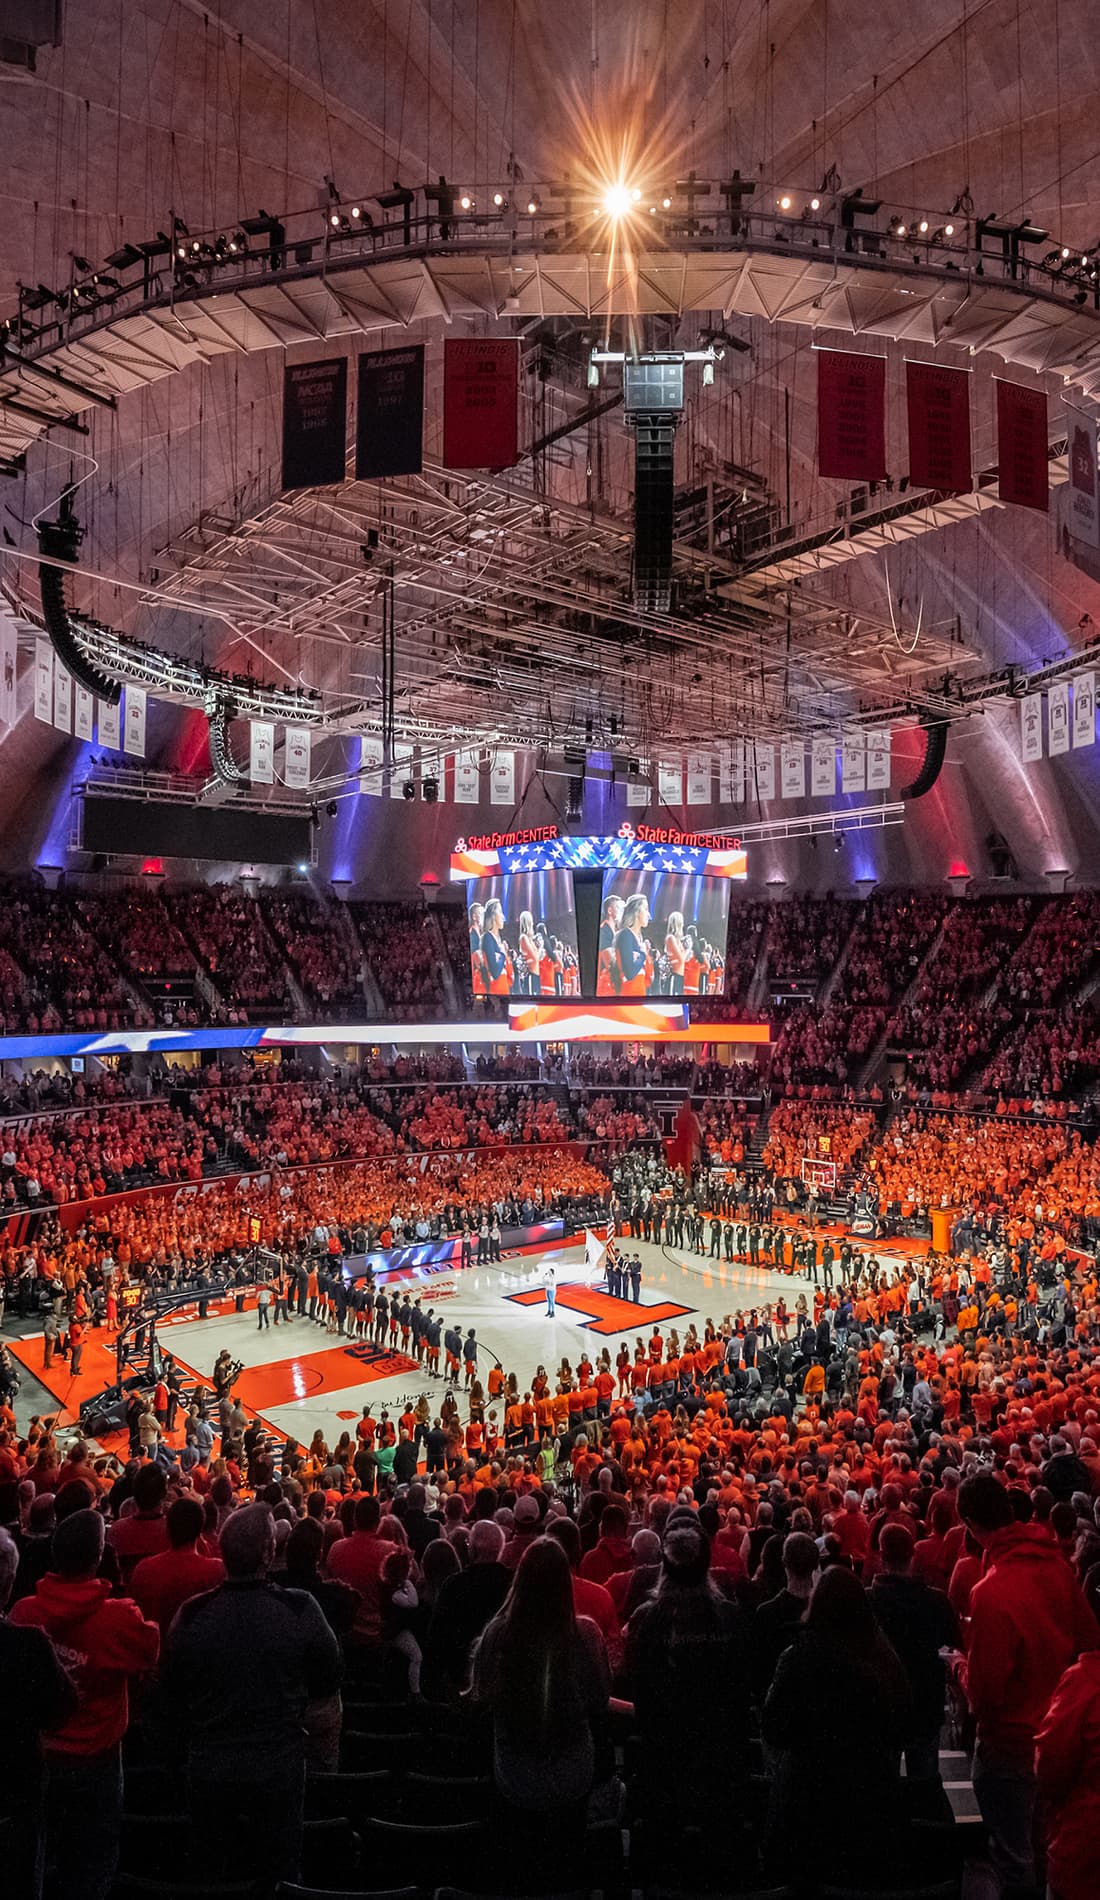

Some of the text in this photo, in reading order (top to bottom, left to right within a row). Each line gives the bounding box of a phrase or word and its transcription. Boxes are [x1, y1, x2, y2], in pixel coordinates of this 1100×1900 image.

[1078, 456, 1089, 476] 32
[516, 825, 558, 844] CENTER
[697, 834, 741, 850] CENTER
